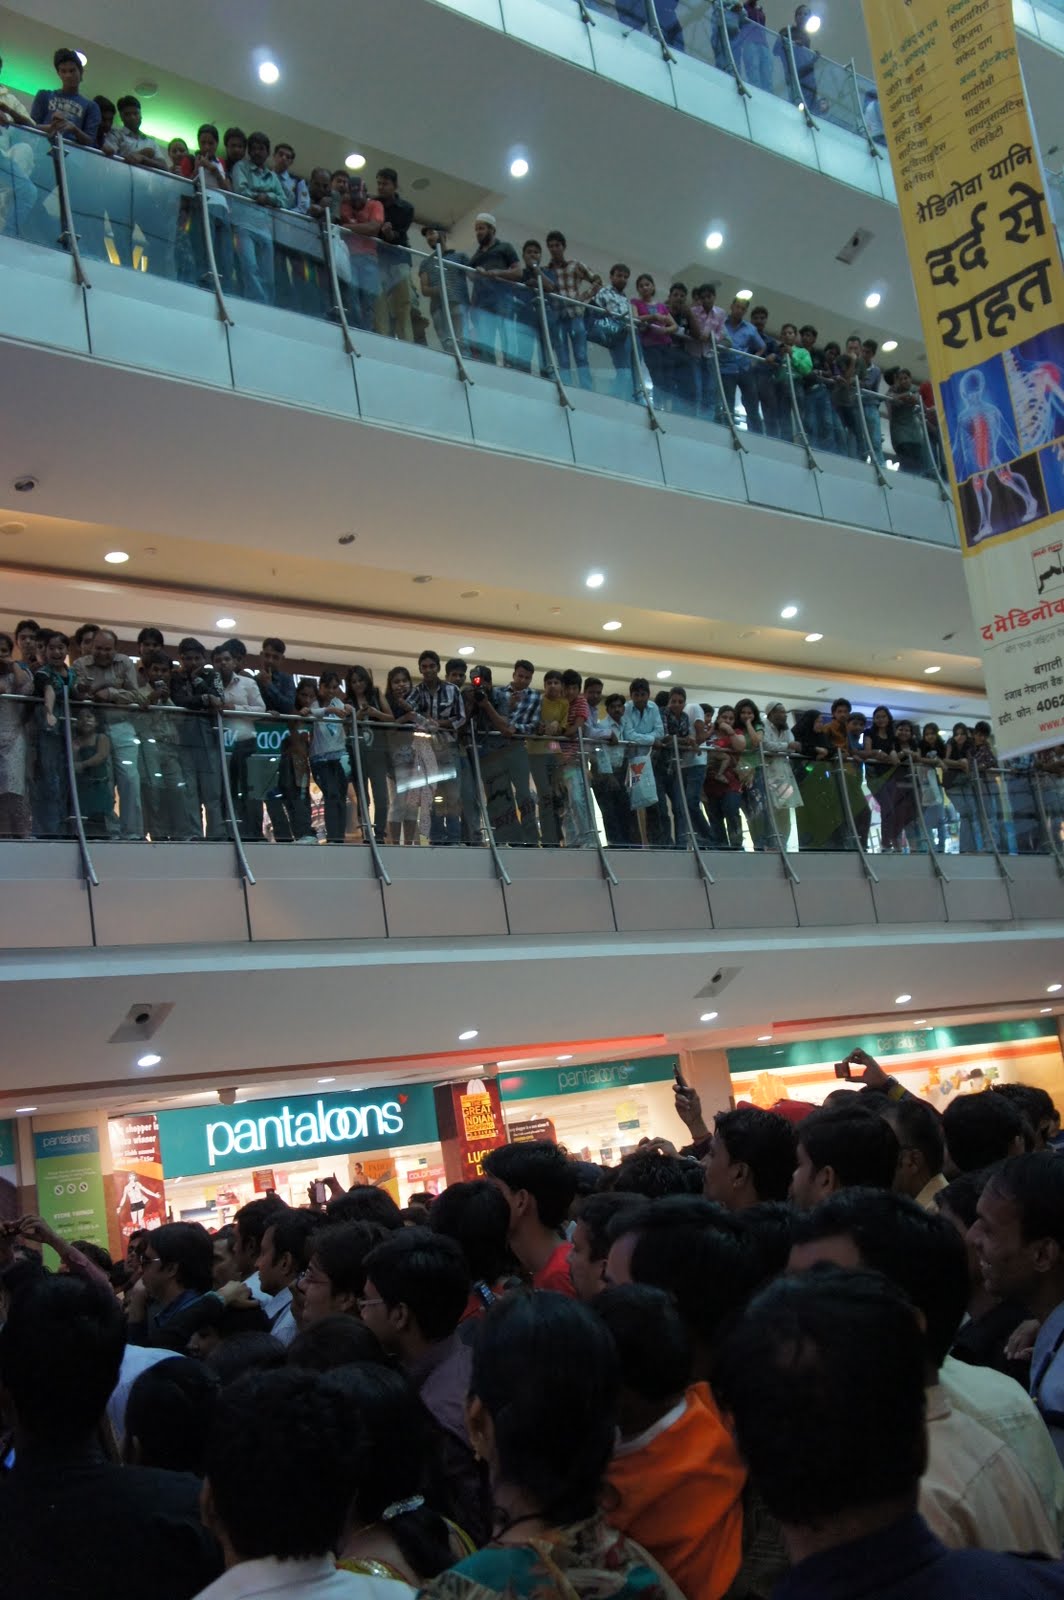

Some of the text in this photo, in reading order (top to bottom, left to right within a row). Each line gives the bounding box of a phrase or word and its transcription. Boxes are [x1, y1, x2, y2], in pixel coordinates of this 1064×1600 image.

[988, 143, 1033, 181] यानि
[925, 181, 1046, 286] दर्द से
[937, 258, 1053, 349] राहत
[557, 1065, 629, 1091] pantaloons
[462, 1104, 491, 1117] GREAT
[42, 1133, 91, 1148] pantaloons
[206, 1100, 404, 1166] pantaloons
